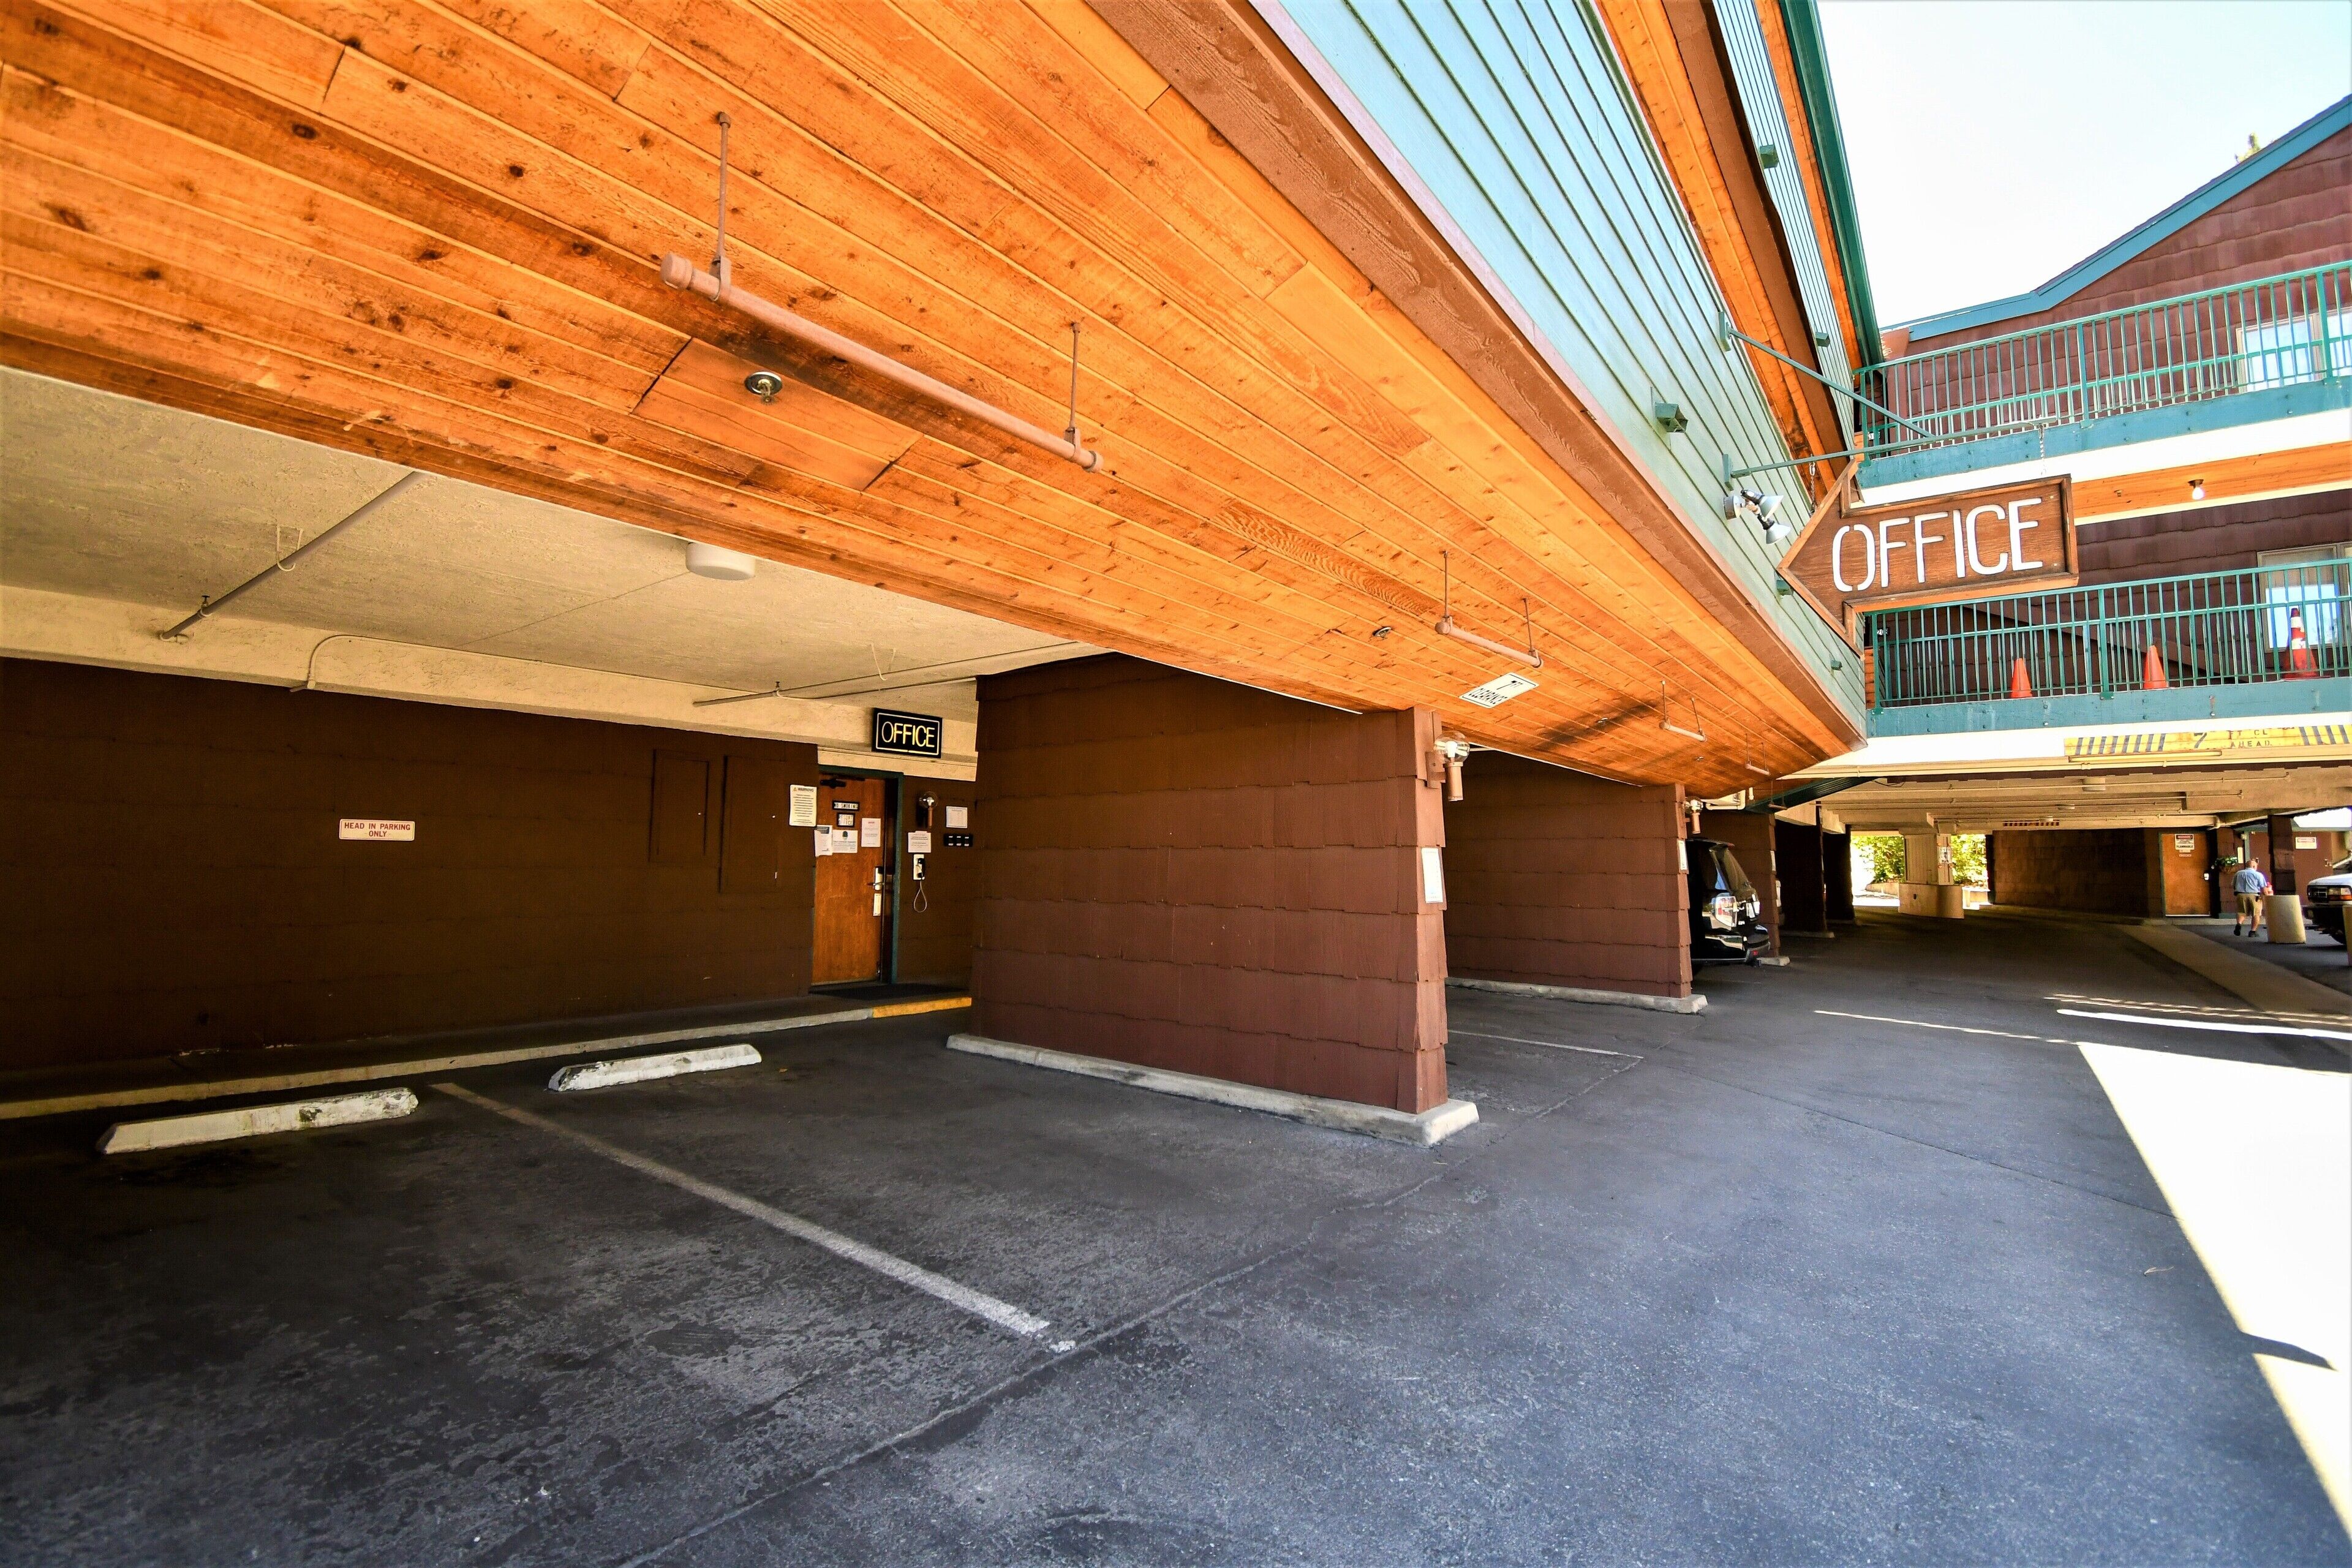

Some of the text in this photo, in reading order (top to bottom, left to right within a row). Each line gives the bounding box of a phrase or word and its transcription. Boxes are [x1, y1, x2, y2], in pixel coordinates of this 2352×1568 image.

[1832, 497, 2043, 592] OFFICE
[1468, 688, 1508, 704] CLEARANCE
[882, 721, 935, 747] OFFICE
[2193, 732, 2207, 748] 7
